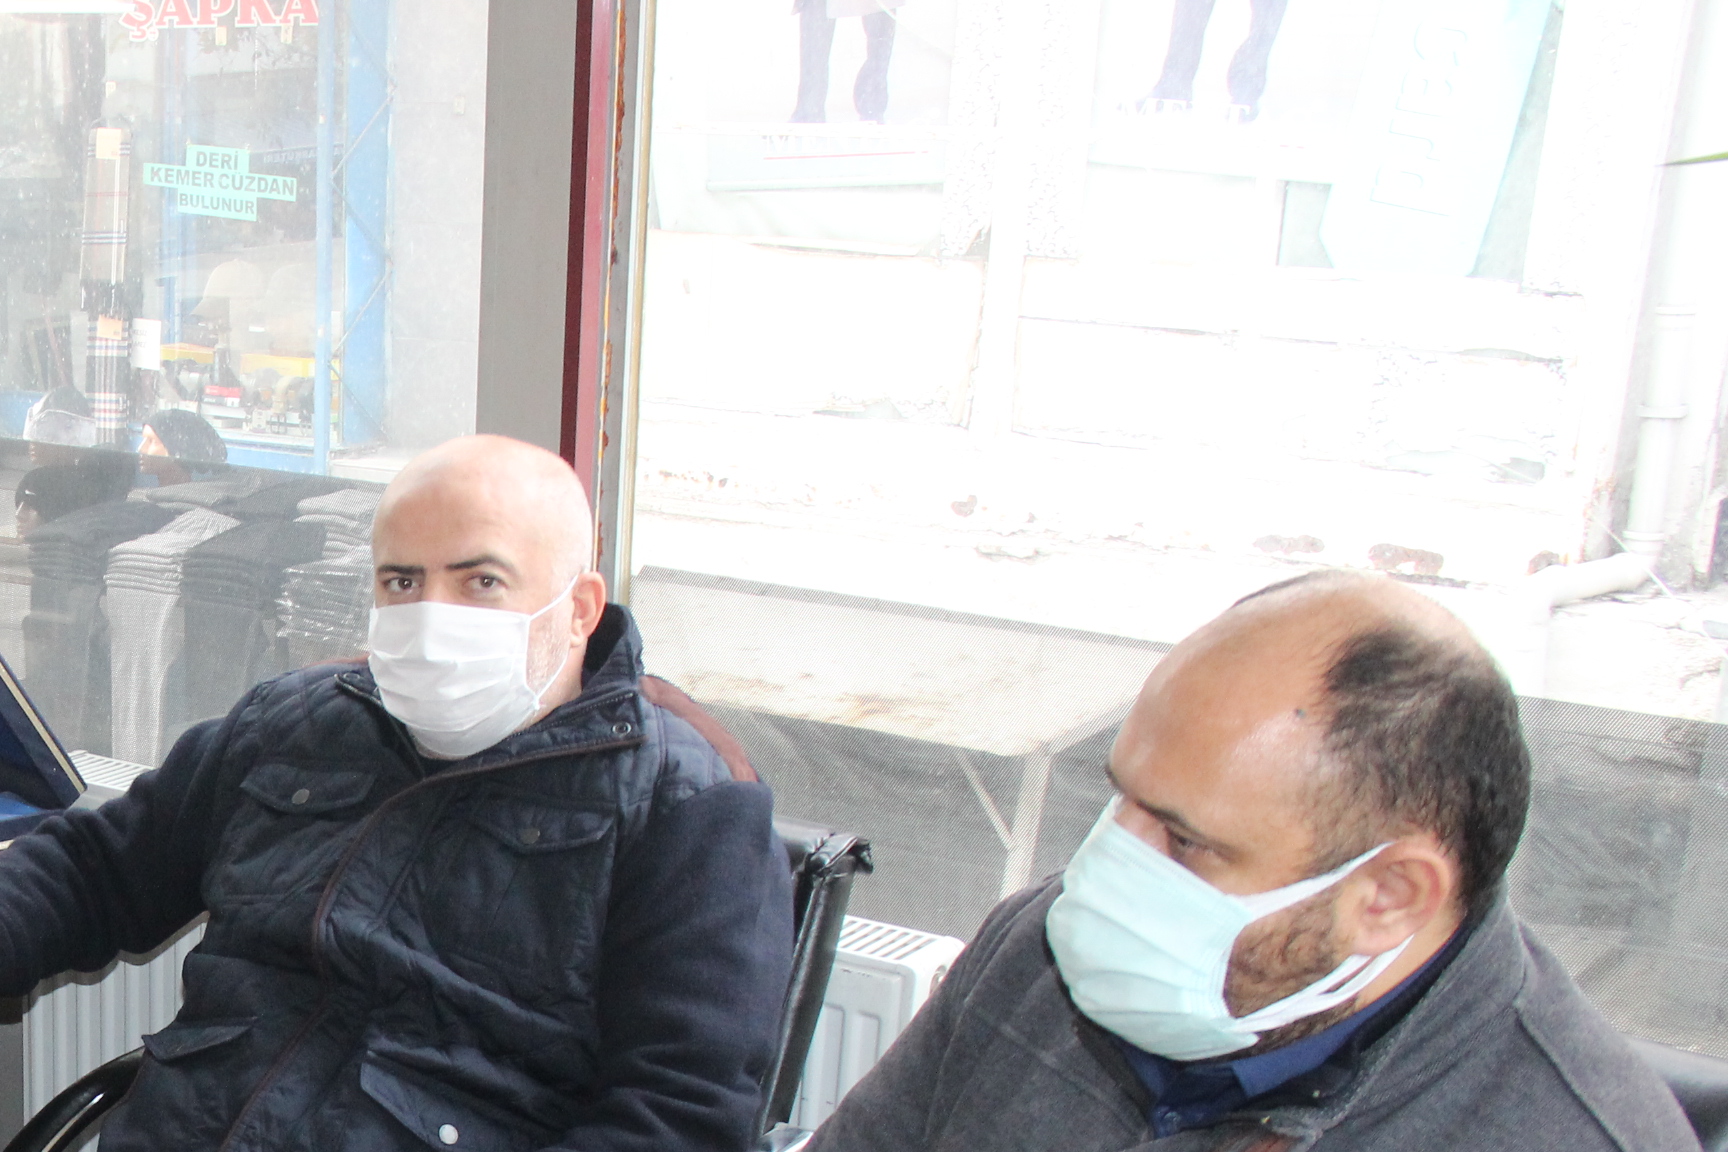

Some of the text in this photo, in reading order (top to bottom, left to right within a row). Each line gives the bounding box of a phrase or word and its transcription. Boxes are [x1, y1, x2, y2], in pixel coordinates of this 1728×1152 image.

[195, 150, 239, 171] DERİ
[150, 166, 295, 196] KEMER CÜZDAN
[179, 193, 256, 215] BULUNUR
